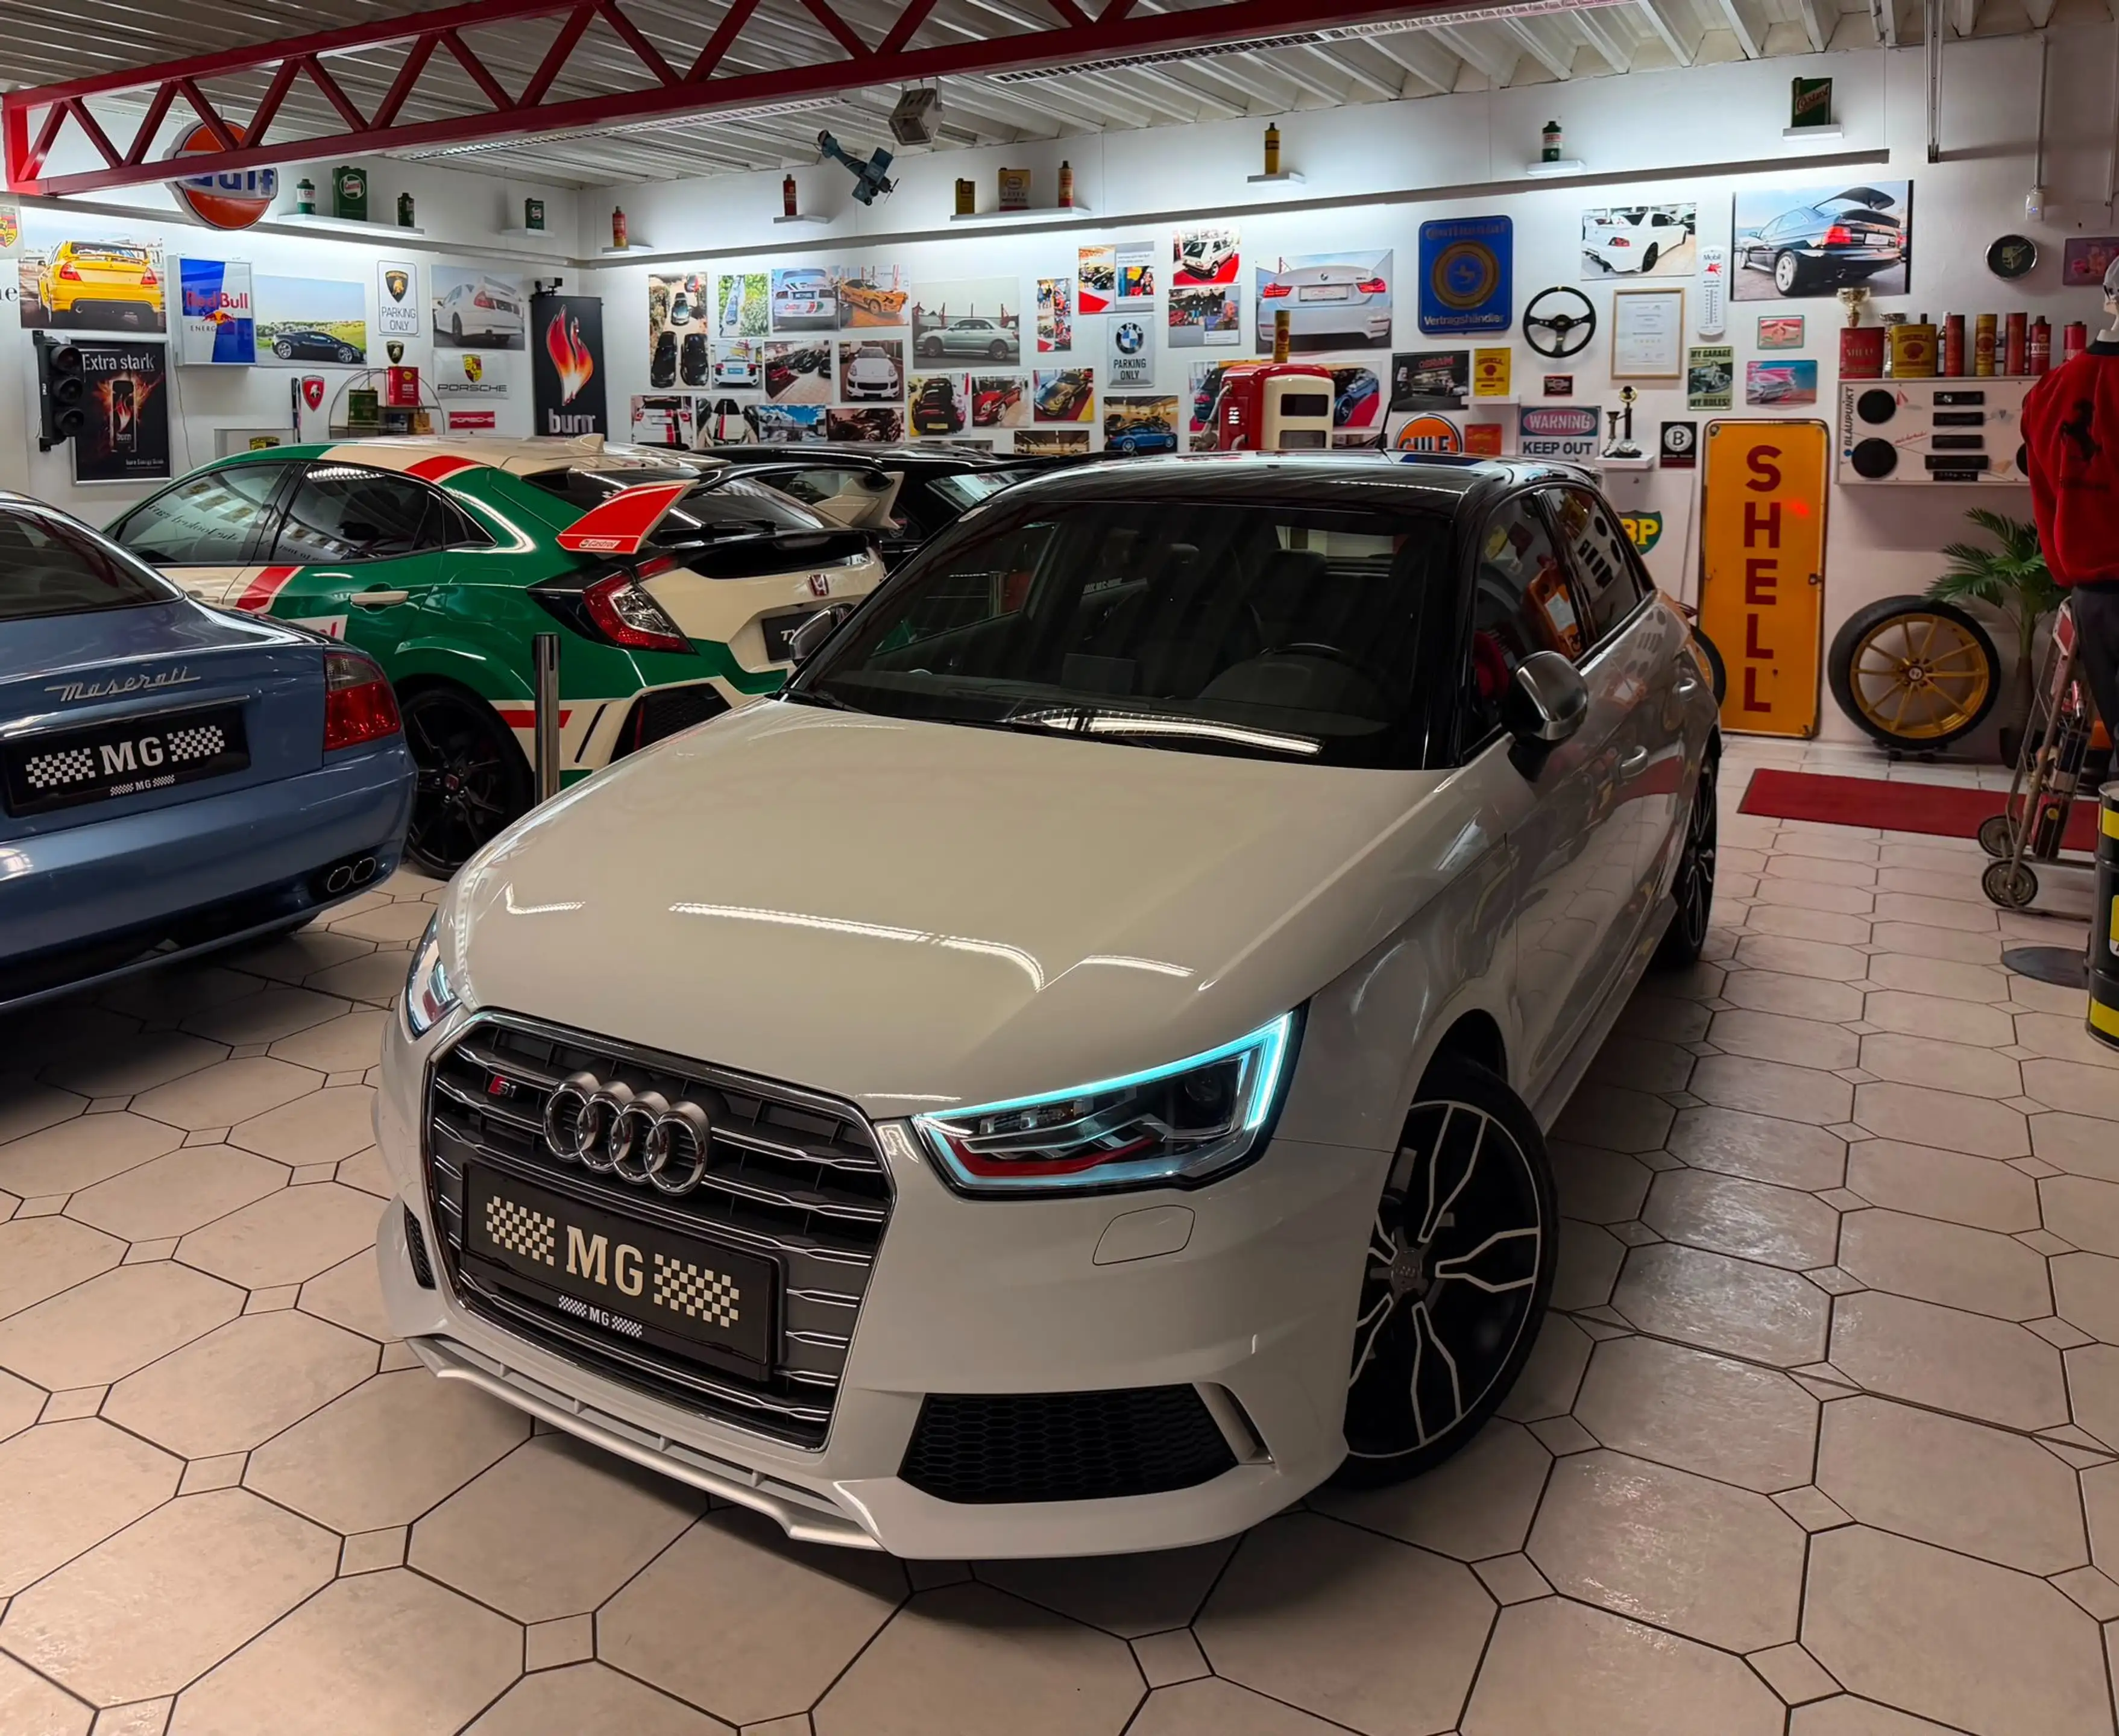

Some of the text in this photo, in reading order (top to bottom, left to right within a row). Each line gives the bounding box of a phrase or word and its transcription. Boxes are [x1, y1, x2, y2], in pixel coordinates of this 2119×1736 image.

[1426, 224, 1506, 240] Continental
[220, 292, 248, 309] Bull
[381, 306, 416, 319] PARKING
[1424, 313, 1505, 326] Vertragshändler
[389, 319, 410, 331] ONLY
[1702, 349, 1731, 357] GARAGE
[82, 352, 154, 371] Extra stark
[1113, 358, 1147, 369] PARKING
[1120, 370, 1140, 380] ONLY
[438, 383, 508, 392] PORSCHE
[1690, 398, 1701, 407] MY
[548, 408, 593, 433] burn
[1529, 414, 1591, 429] WARNING
[1843, 386, 1854, 447] BLAUPUNKT
[1672, 430, 1684, 445] B
[1523, 442, 1593, 455] KEEP OUT
[1620, 518, 1658, 545] BP
[588, 539, 617, 547] Castrol
[1743, 445, 1783, 712] SHELL
[45, 665, 201, 702] Maserati
[99, 737, 163, 775] MG
[135, 779, 151, 791] MG
[496, 1080, 517, 1098] S1
[566, 1225, 644, 1296] MG
[588, 1306, 609, 1326] MG
